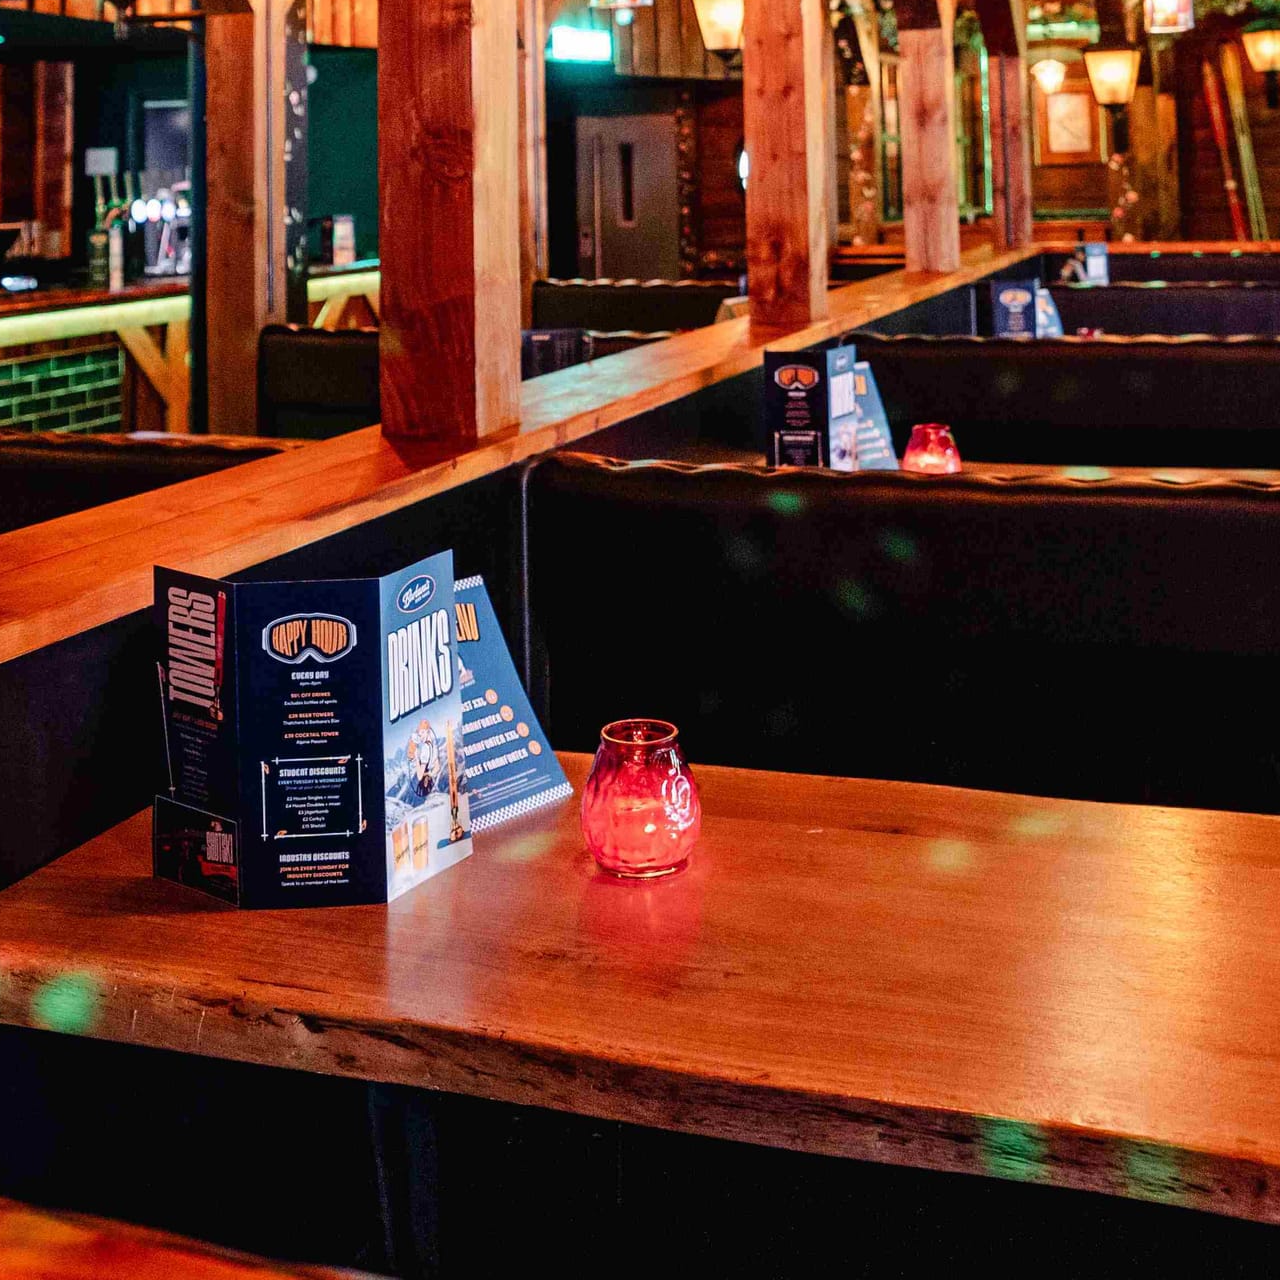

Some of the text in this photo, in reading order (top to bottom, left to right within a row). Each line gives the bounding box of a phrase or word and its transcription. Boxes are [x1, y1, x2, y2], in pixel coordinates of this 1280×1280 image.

[168, 586, 216, 709] TOWERS
[272, 619, 347, 657] HAPPY HOUR
[291, 670, 329, 680] EVERY DAY
[388, 609, 453, 721] DRINKS
[279, 766, 347, 777] STUDENT DISCOUNTS
[279, 851, 350, 862] INDUSTRY DISCOUNTS
